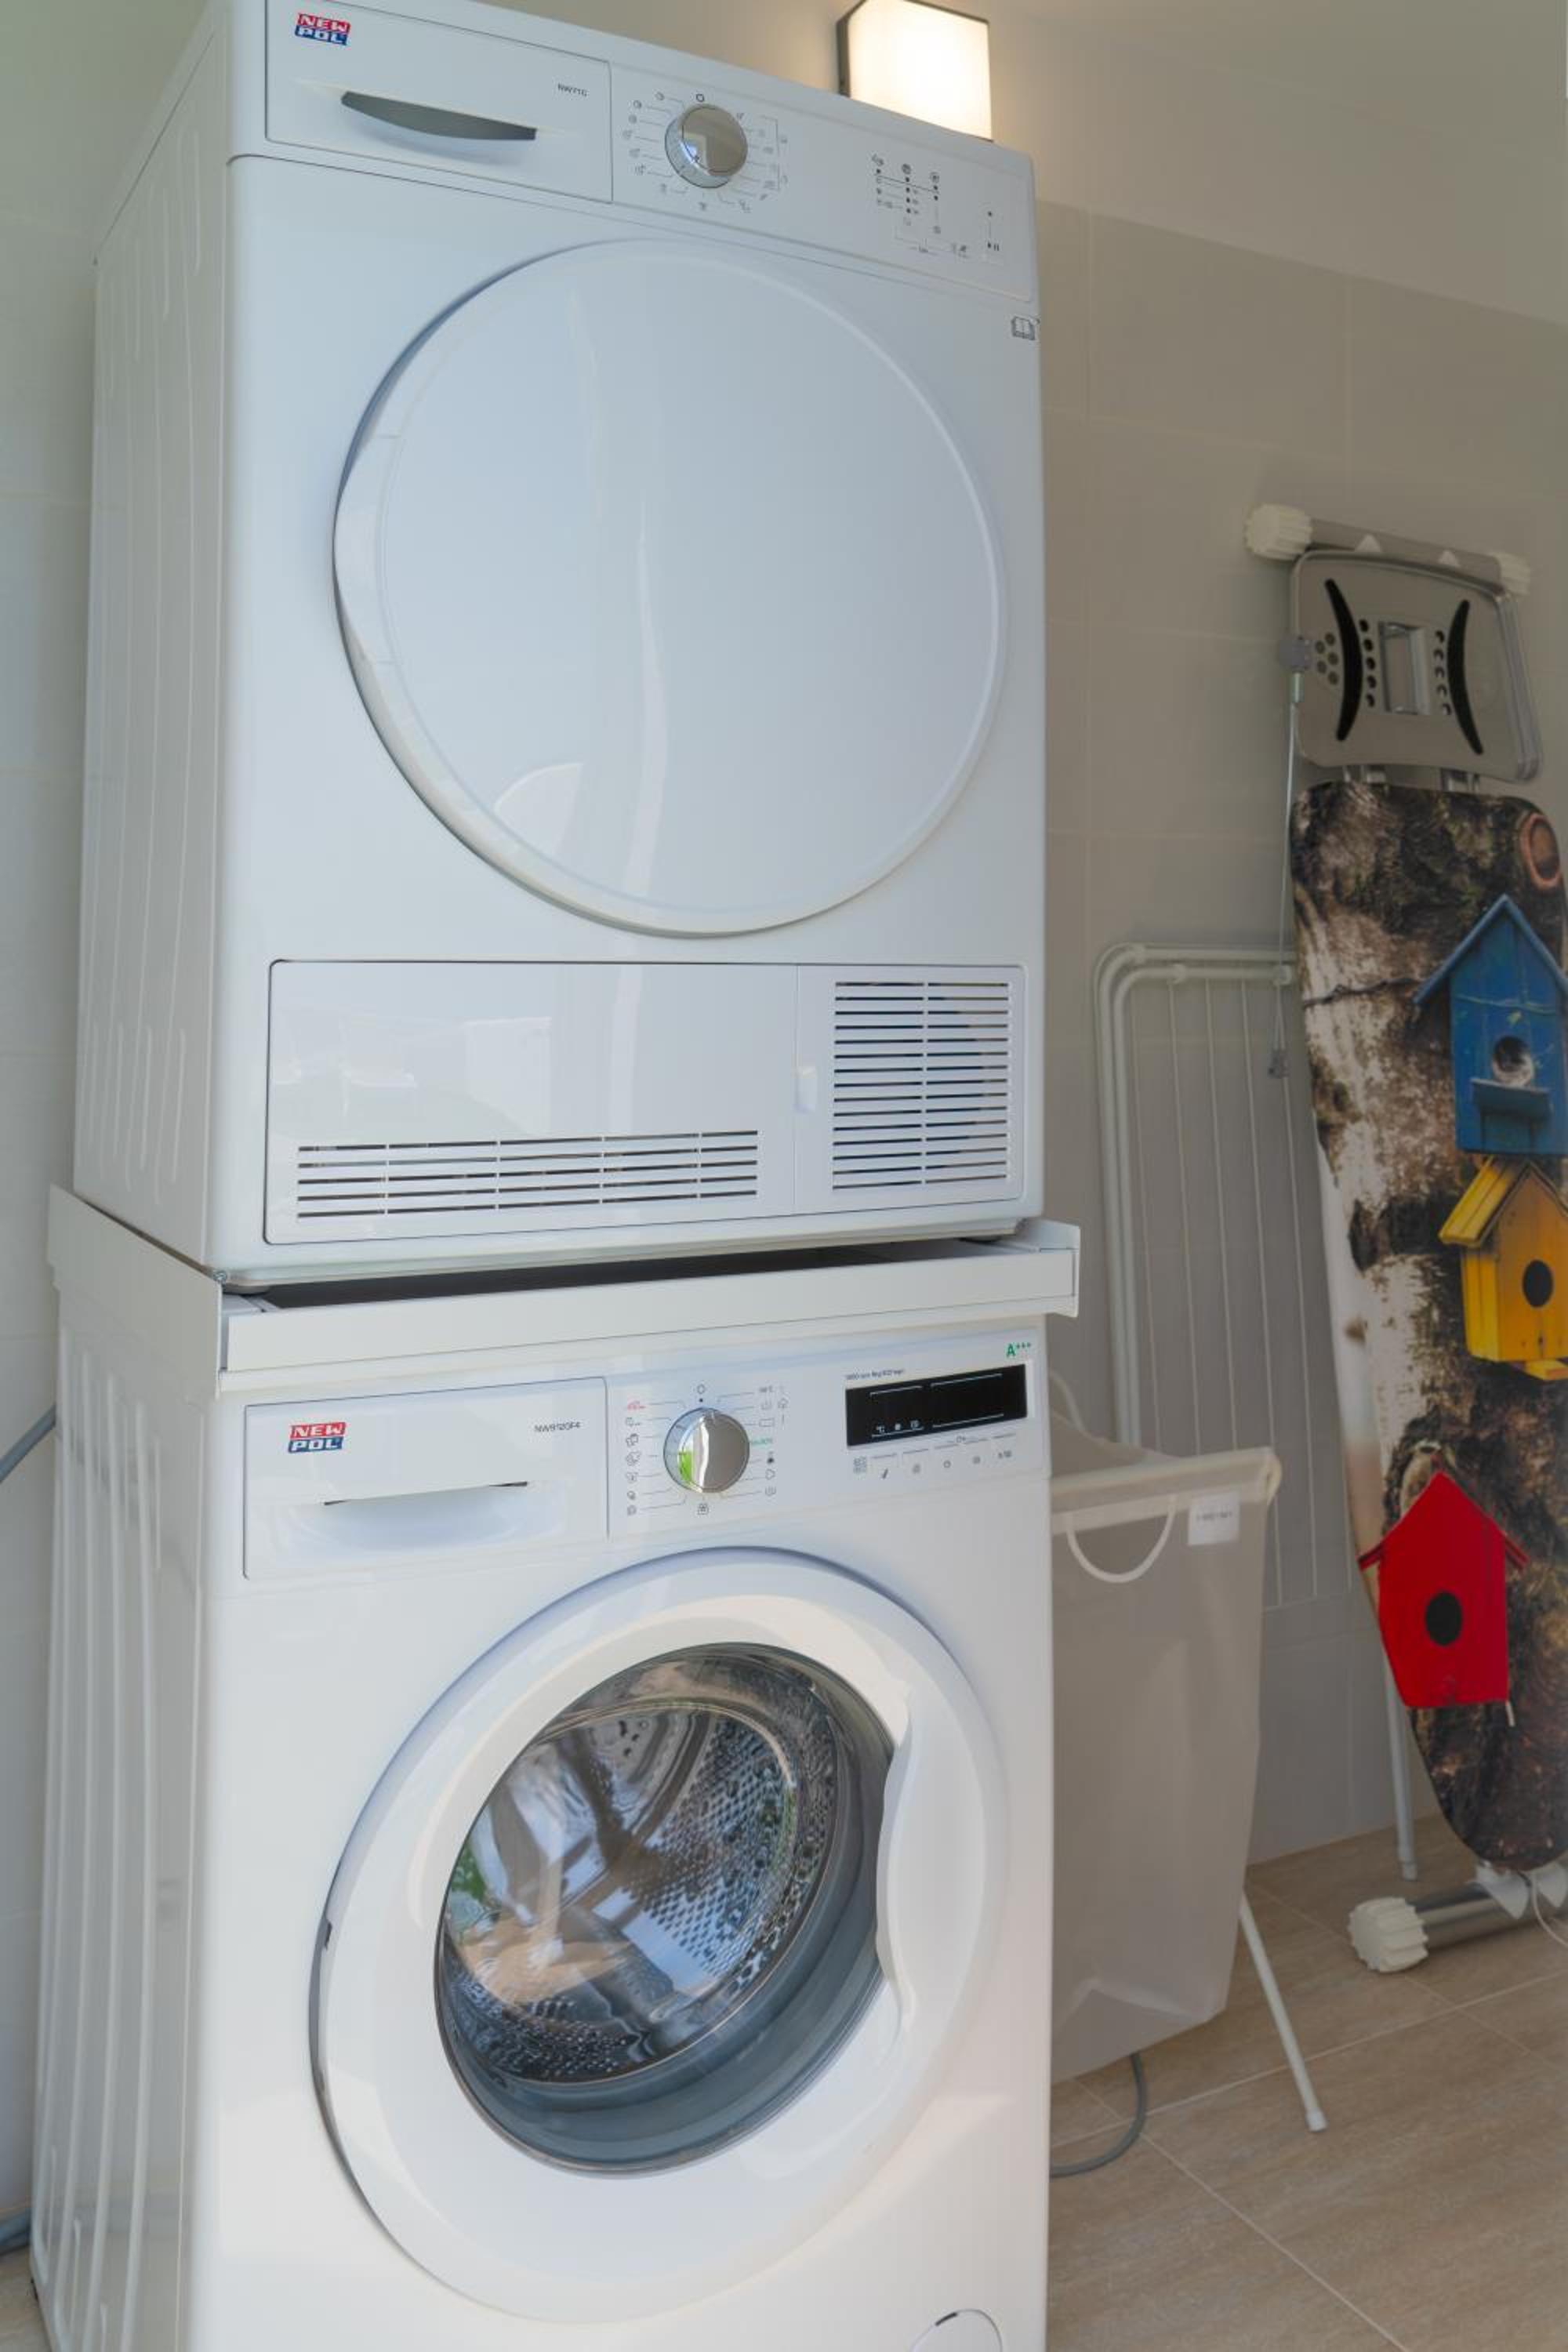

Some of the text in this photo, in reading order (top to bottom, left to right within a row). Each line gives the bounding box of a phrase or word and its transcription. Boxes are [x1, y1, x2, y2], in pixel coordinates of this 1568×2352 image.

[299, 13, 350, 32] NEW
[297, 26, 345, 43] POL
[292, 1423, 345, 1438] NEW
[290, 1437, 343, 1452] POL
